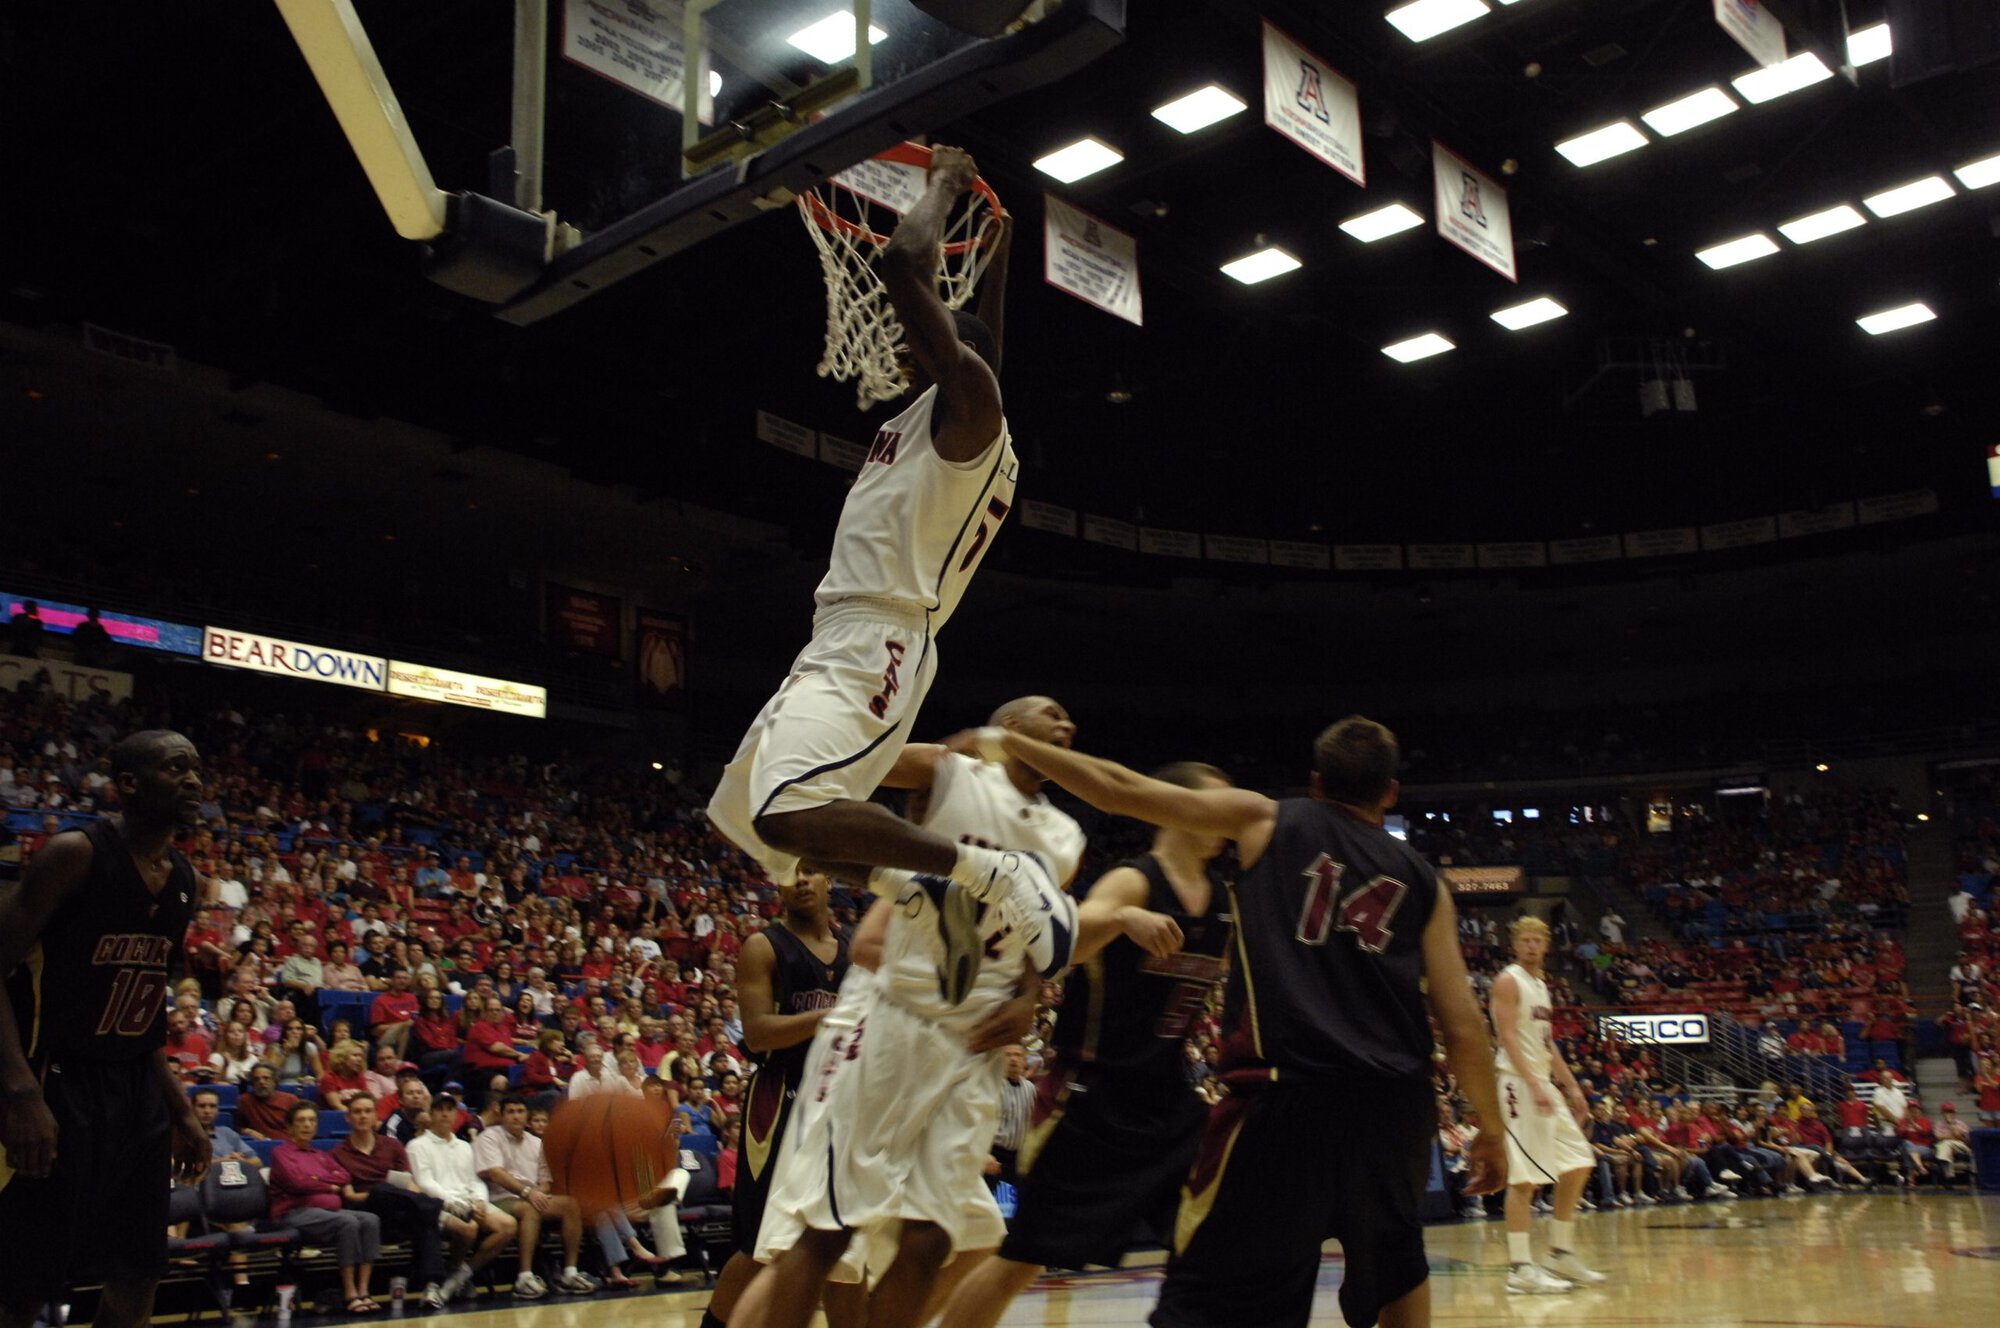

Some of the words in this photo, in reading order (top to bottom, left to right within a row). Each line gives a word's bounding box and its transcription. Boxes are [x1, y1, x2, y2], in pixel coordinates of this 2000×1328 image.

[868, 640, 905, 720] CATS
[1295, 851, 1408, 955] 14
[95, 967, 168, 1037] 10
